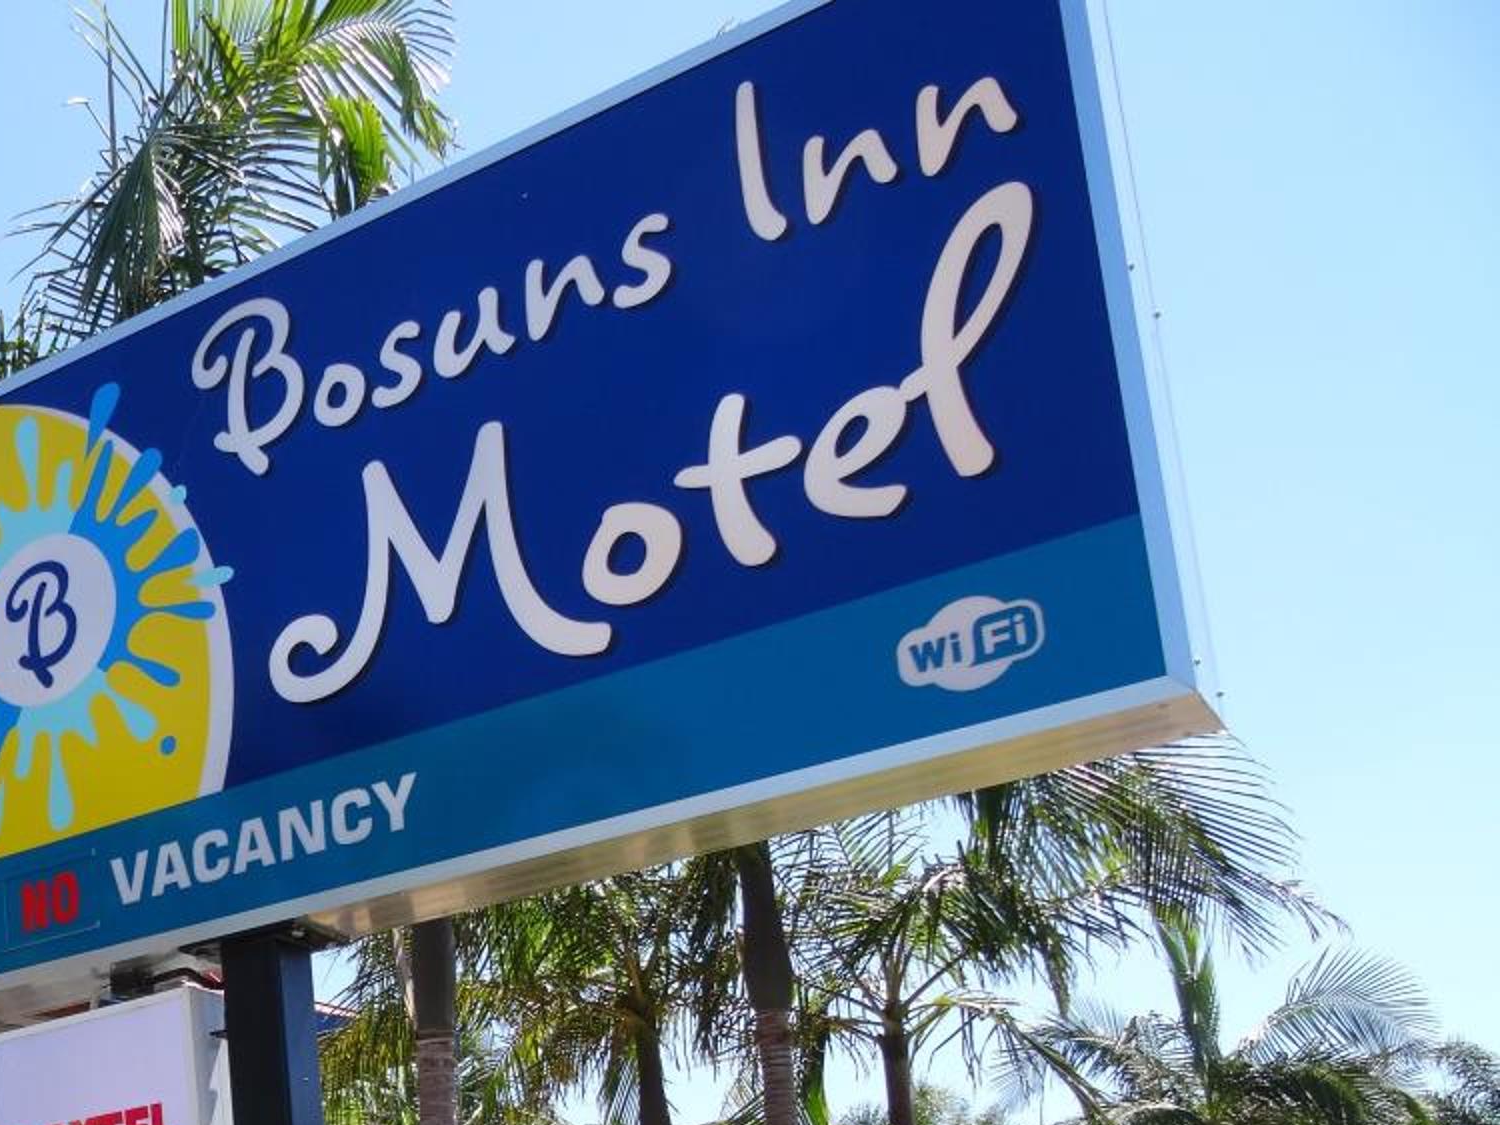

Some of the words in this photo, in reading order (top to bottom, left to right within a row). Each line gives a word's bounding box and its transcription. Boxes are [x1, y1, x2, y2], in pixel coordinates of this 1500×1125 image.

[192, 213, 672, 475] Bosuns
[736, 77, 1018, 241] Inn
[269, 181, 1034, 703] Motel
[5, 560, 77, 688] B
[20, 871, 80, 933] NO
[109, 772, 417, 905] VACANCY
